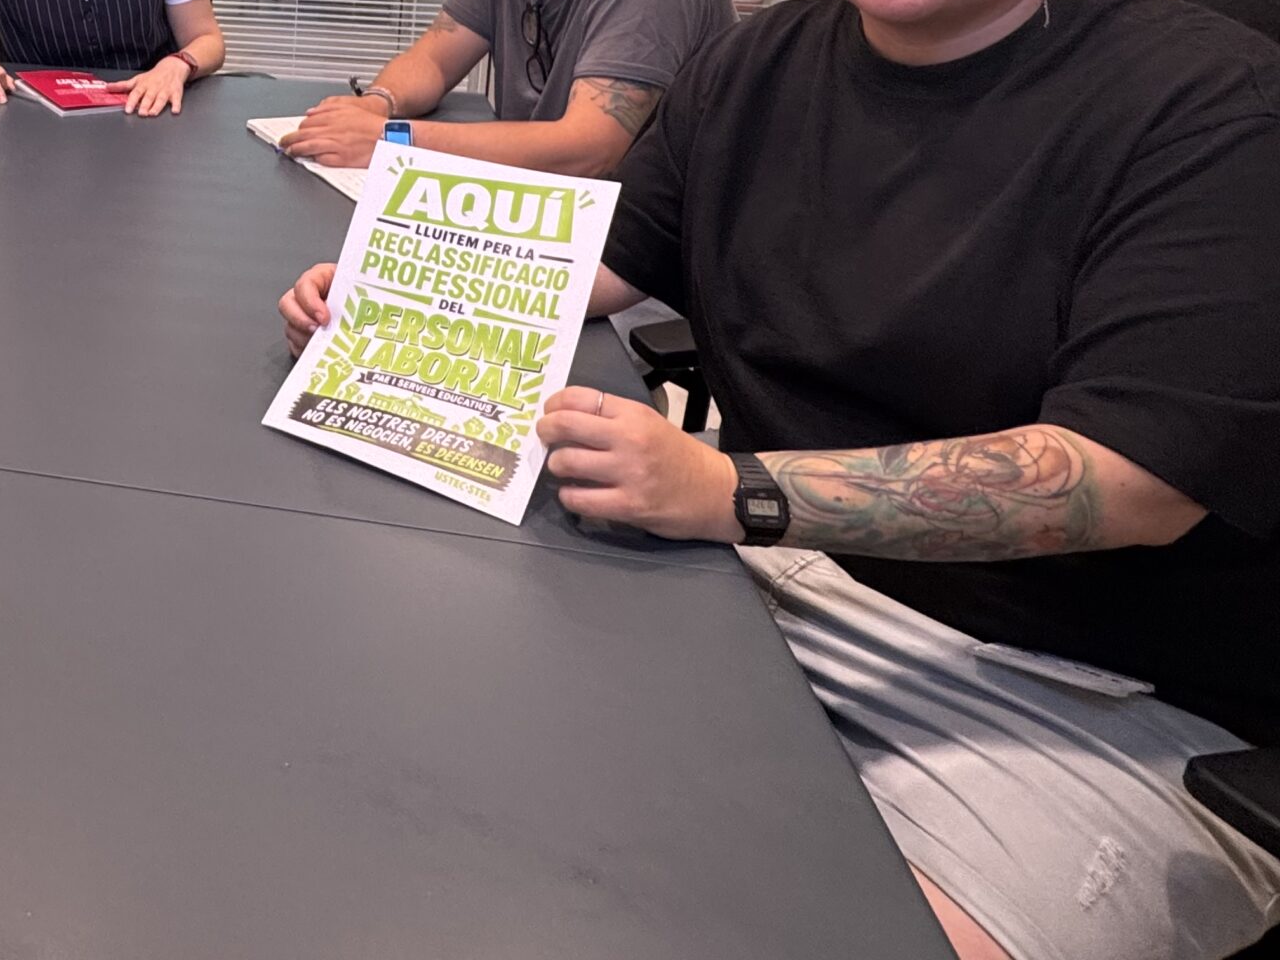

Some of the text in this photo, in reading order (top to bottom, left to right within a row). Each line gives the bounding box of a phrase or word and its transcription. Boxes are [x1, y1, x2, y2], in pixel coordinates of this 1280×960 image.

[396, 176, 566, 239] AQUÍ
[368, 227, 570, 291] RECLASSIFICACIÓ
[415, 224, 535, 261] LLUITEM PER LA
[360, 250, 561, 320] PROFESSIONAL
[438, 299, 465, 315] DEL
[352, 296, 545, 373] PERSONAL
[349, 337, 524, 411] LABORAL
[372, 373, 390, 383] PAE
[397, 378, 438, 397] SERVEIS
[437, 391, 494, 413] EDUCATIUS
[301, 409, 505, 478] NO ES NEGOCIEN, ES DEFENSEN
[316, 399, 474, 452] ELS NOSTRES DRETS
